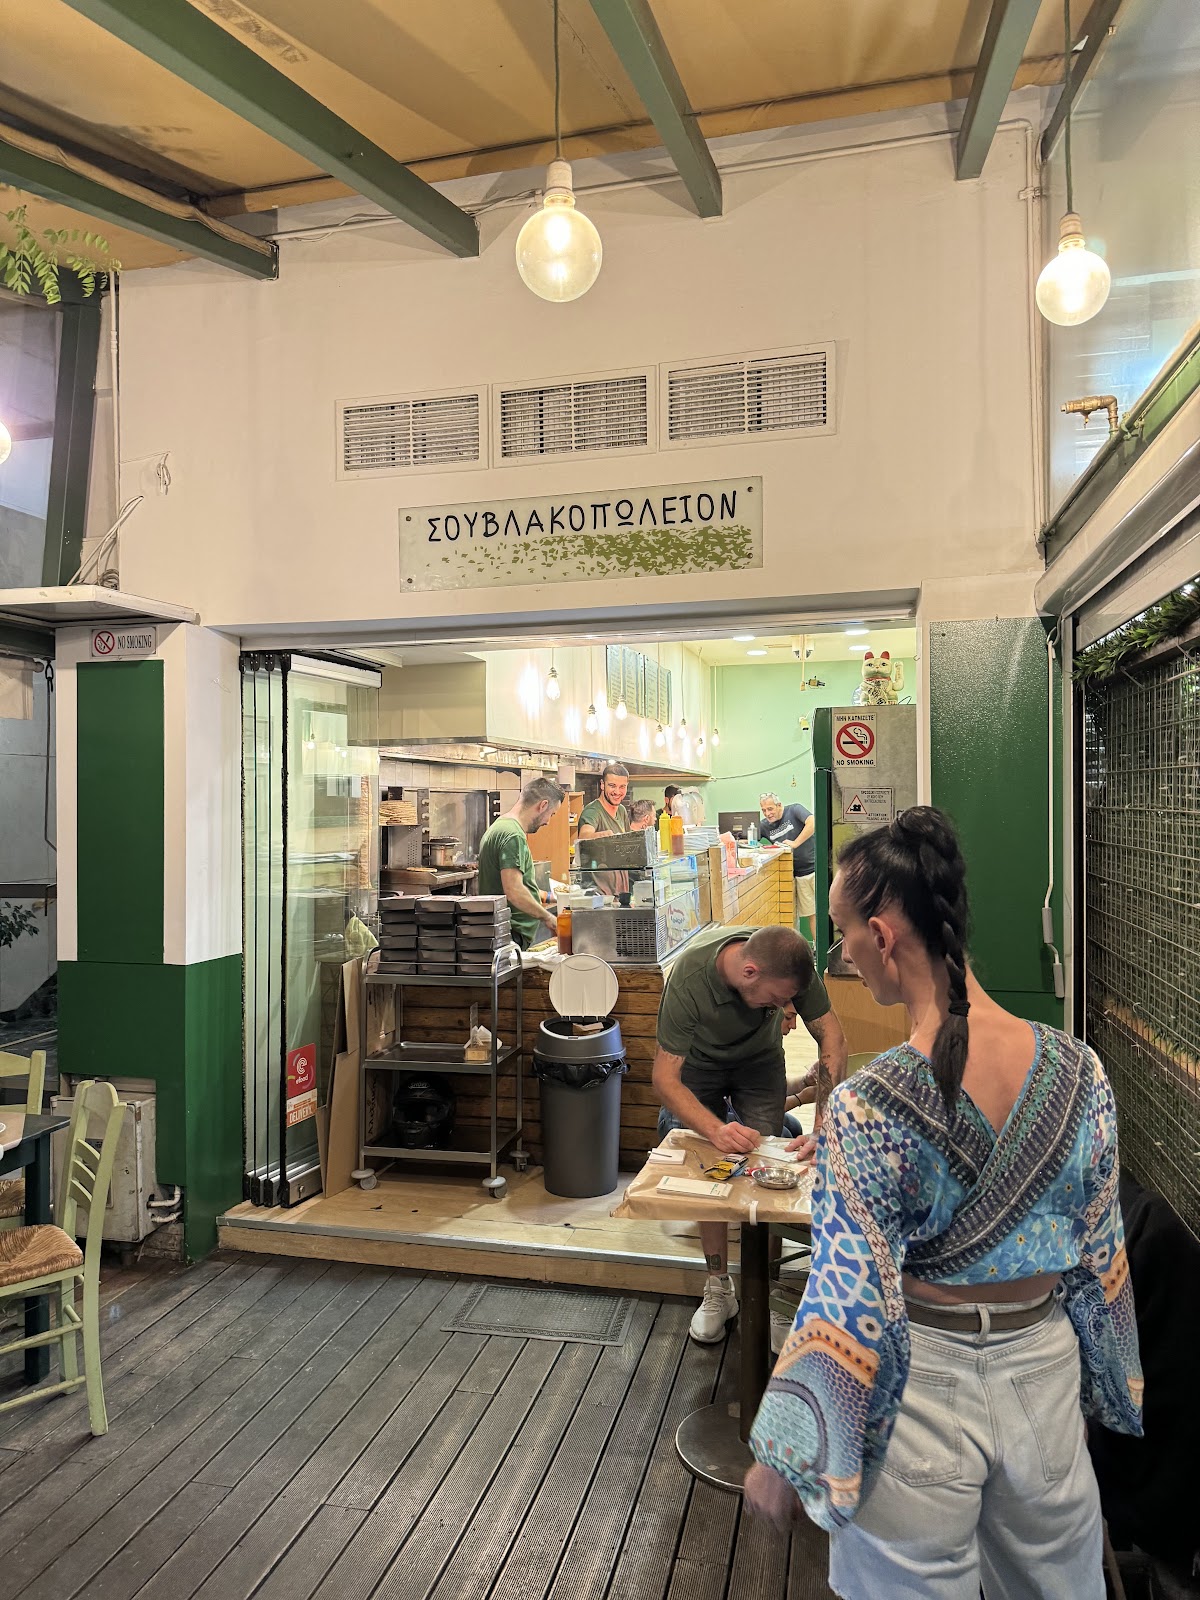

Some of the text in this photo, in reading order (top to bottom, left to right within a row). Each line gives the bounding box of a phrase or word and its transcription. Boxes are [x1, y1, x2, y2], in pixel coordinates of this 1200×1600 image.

[428, 490, 737, 542] ΣΟΥΒΛΑΚΟΠΩΛΕΙΟΝ
[117, 635, 152, 649] NO SMOKING
